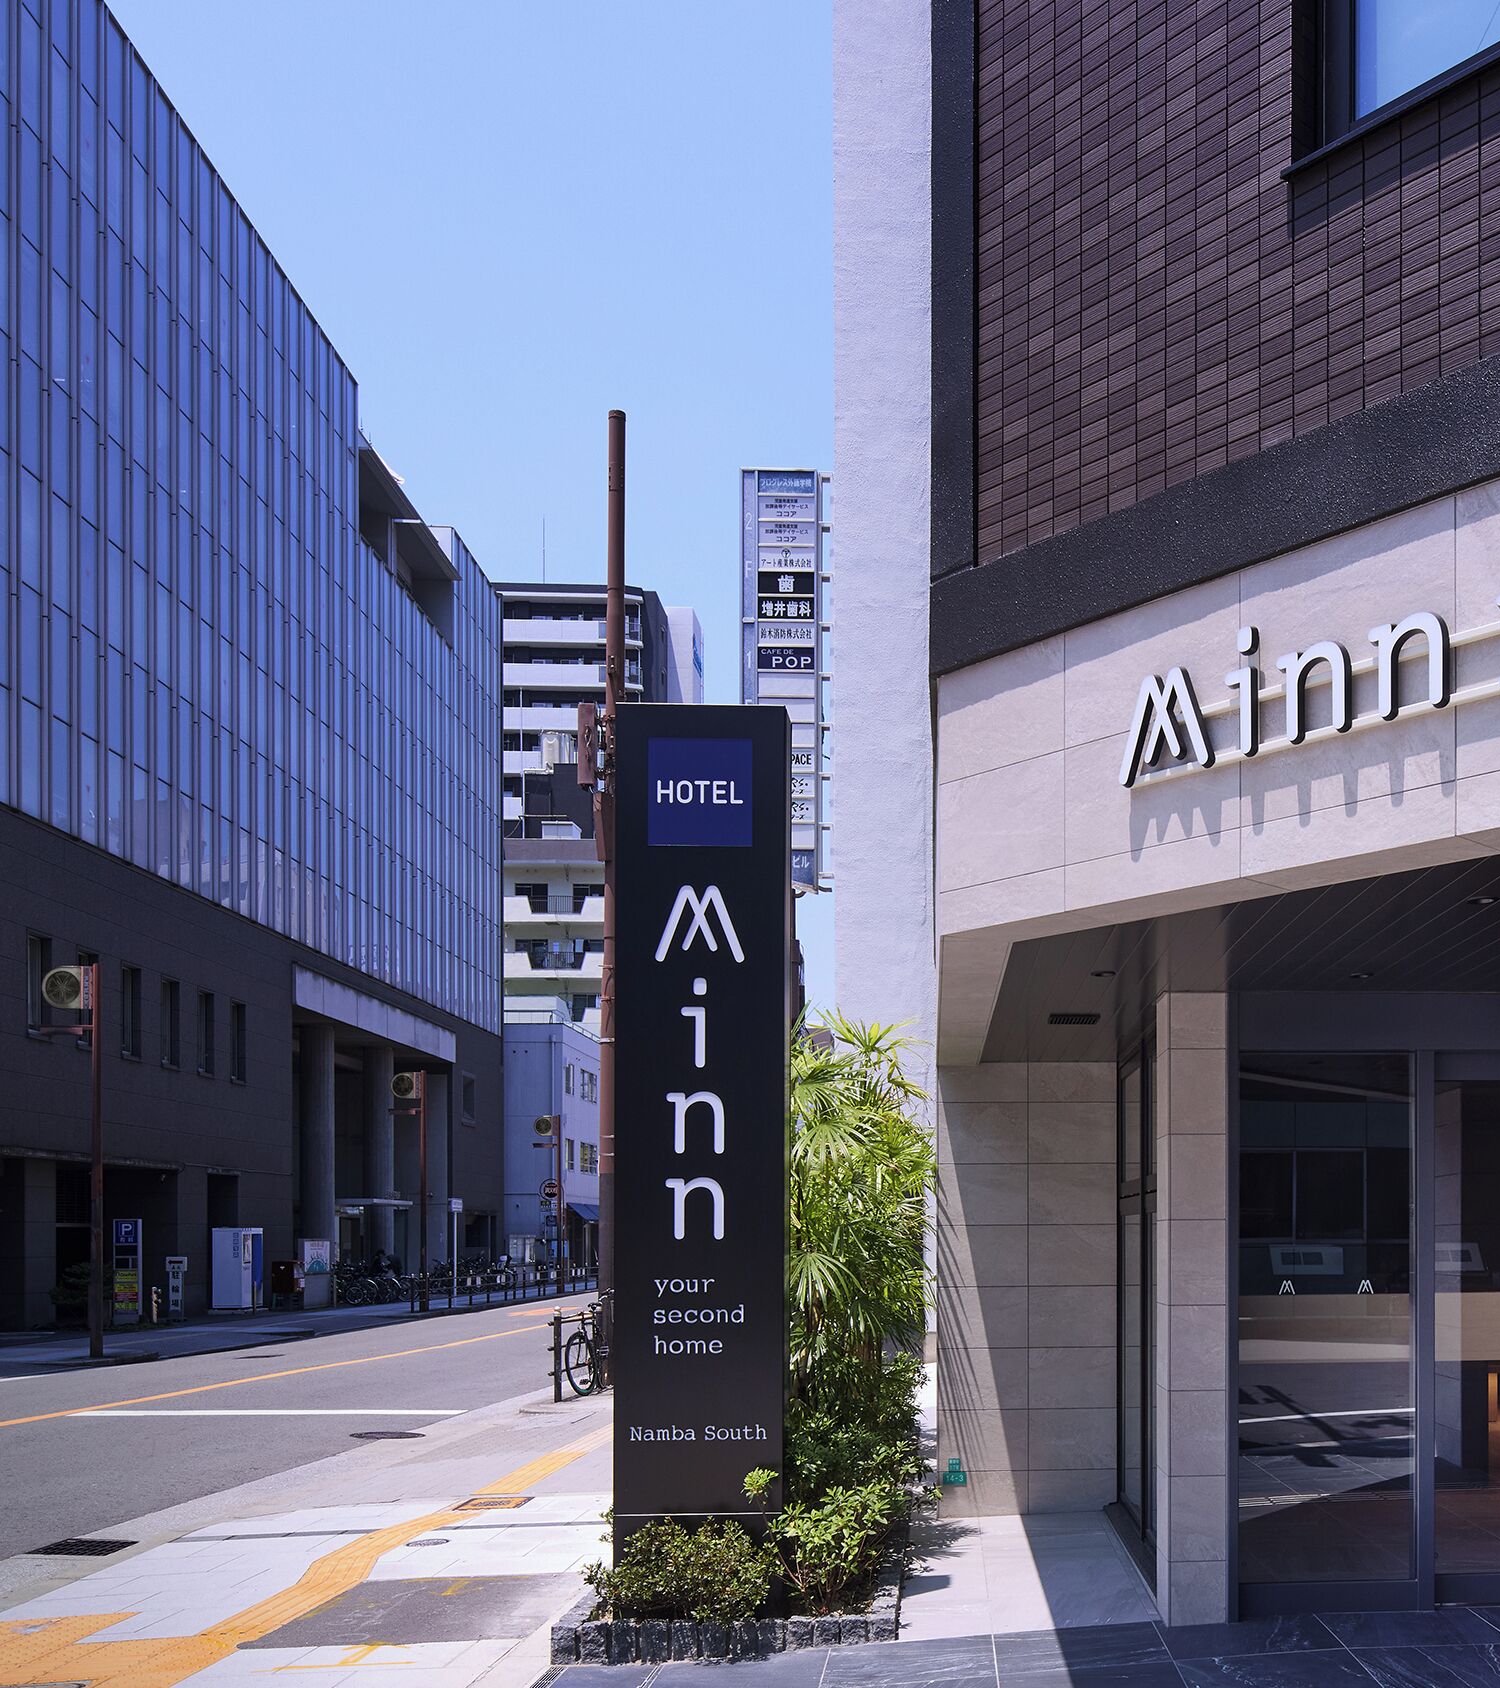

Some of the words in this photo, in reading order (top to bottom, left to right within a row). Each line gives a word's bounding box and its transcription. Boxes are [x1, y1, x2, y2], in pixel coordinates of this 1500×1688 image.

[777, 574, 795, 593] 歯
[761, 600, 812, 617] 増井歯科
[771, 656, 812, 668] POP
[1120, 611, 1450, 788] Minn
[656, 779, 744, 805] HOTEL
[654, 884, 745, 1240] Minn
[121, 1223, 133, 1236] P
[654, 1278, 715, 1298] your
[653, 1304, 745, 1324] second
[654, 1335, 723, 1355] home
[629, 1424, 696, 1442] Namba
[704, 1424, 767, 1441] South
